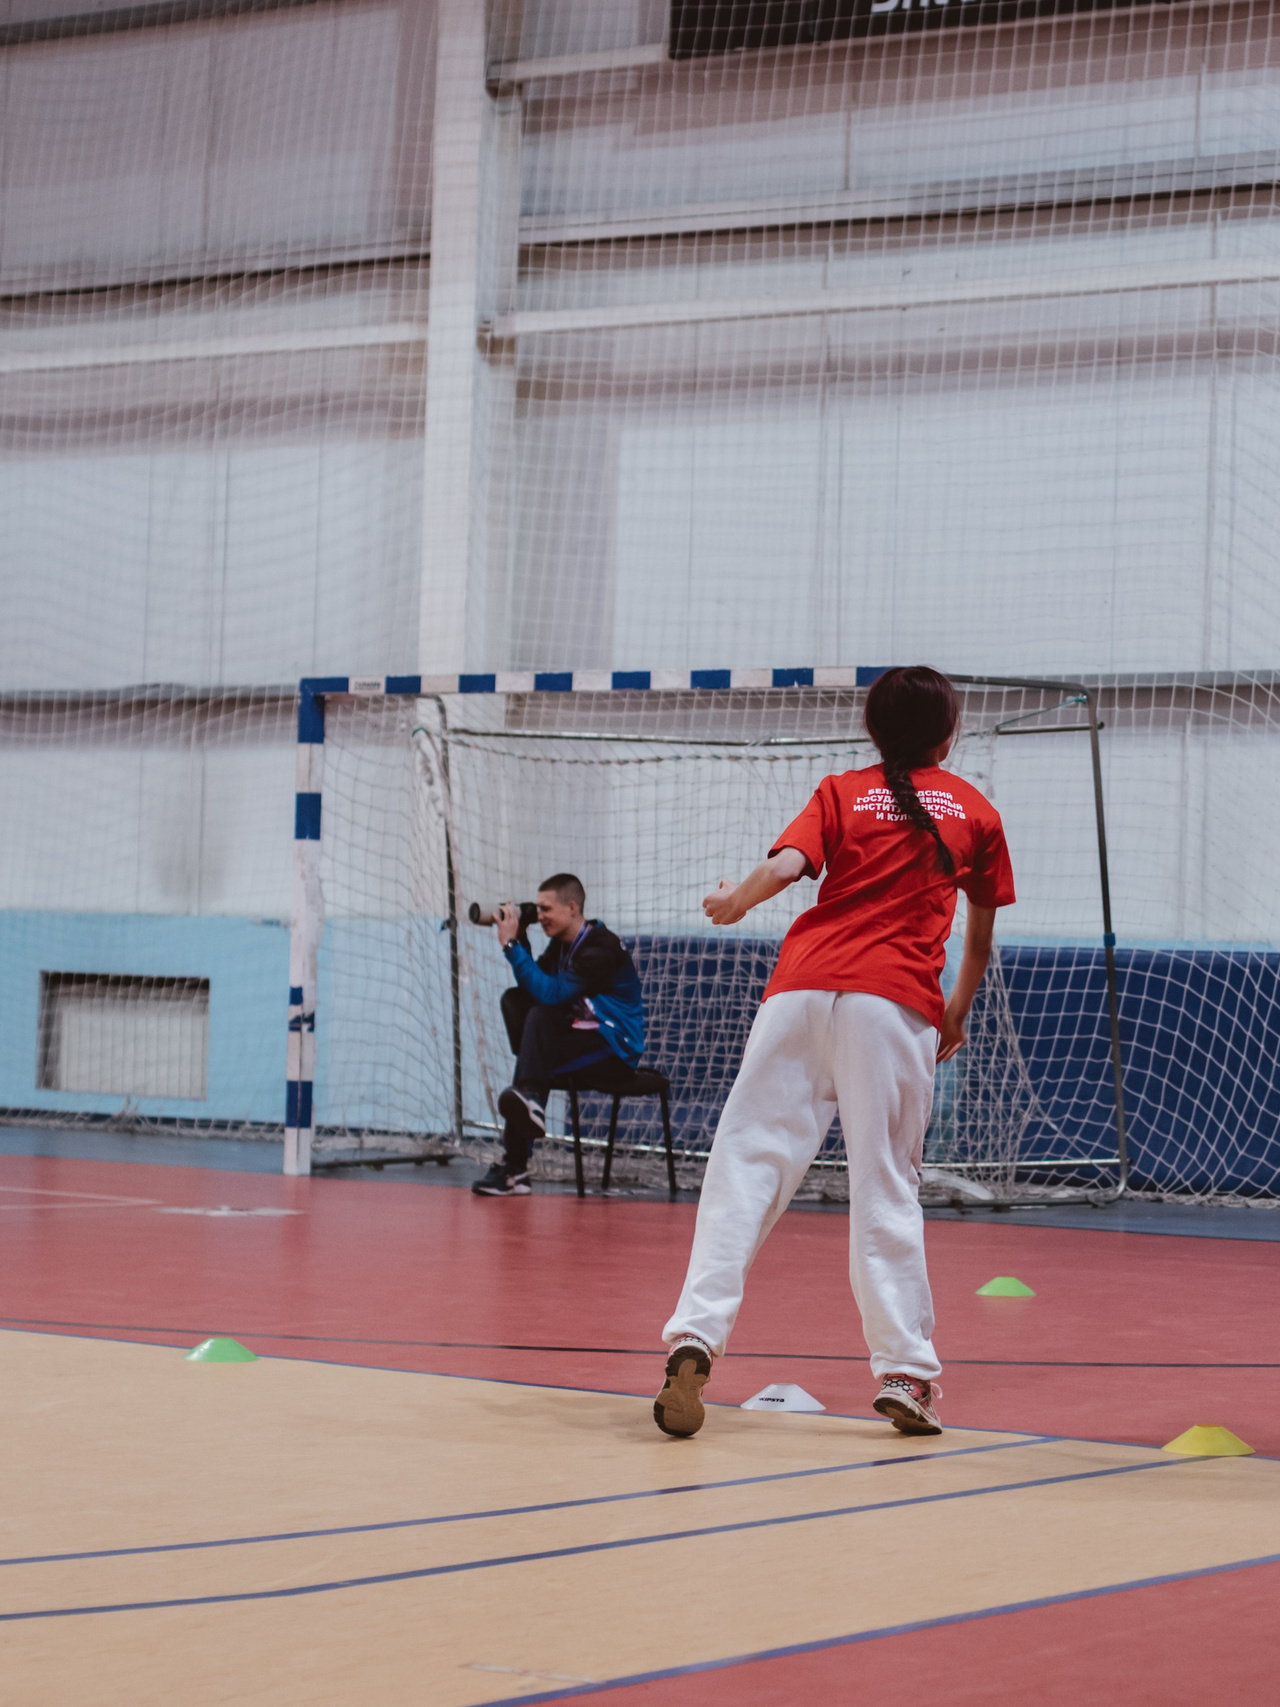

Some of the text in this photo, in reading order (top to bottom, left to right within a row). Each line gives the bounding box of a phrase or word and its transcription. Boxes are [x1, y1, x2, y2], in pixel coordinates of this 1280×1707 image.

[868, 788, 953, 800] БЕЛДСКИЙ
[853, 803, 902, 813] ИНСТИТУ
[856, 795, 963, 811] ГОСУДАВЕННЫЙ
[876, 812, 884, 820] И
